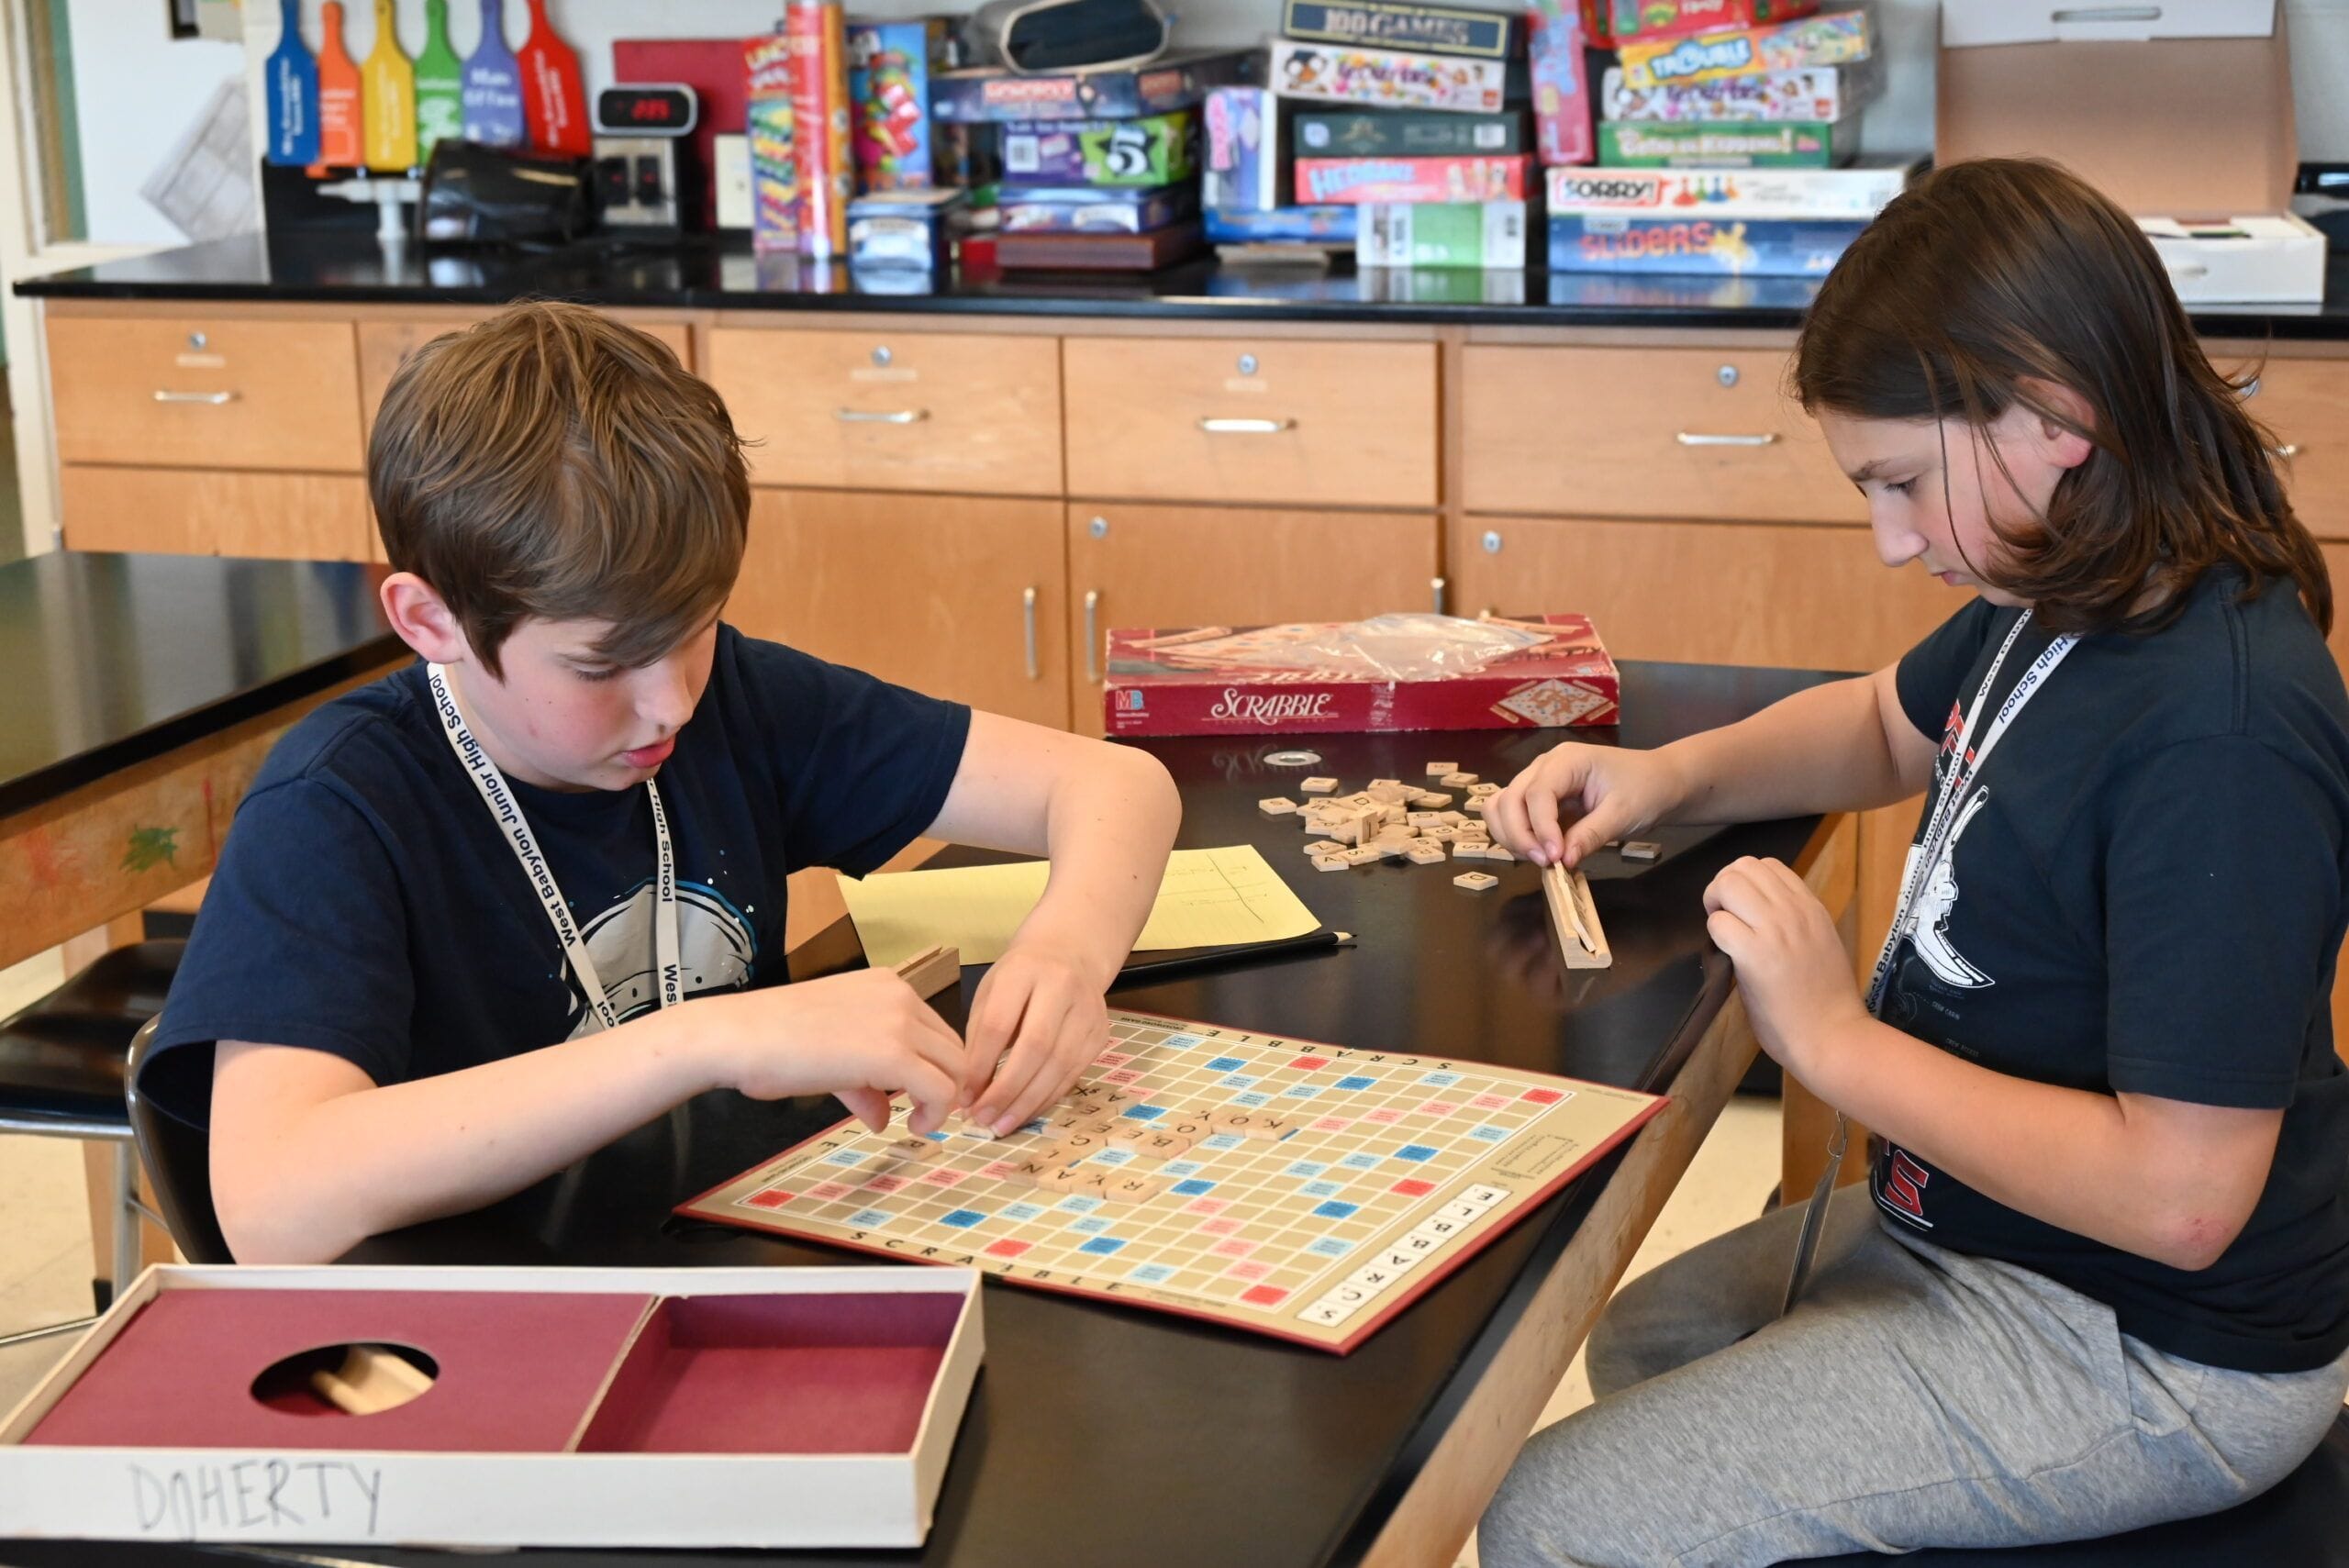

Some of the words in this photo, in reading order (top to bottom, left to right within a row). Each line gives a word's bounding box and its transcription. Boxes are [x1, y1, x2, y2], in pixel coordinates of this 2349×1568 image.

[1107, 128, 1147, 177] 5
[1978, 660, 2001, 697] West
[2039, 635, 2069, 671] High
[429, 673, 462, 730] School
[1115, 689, 1144, 711] MB
[1210, 688, 1332, 726] SCRABBLE
[1998, 671, 2038, 725] School
[457, 732, 486, 771] High
[481, 770, 518, 825] Junior
[512, 828, 555, 898] Babylon
[662, 840, 674, 903] School
[1876, 909, 1905, 973] Babylon
[1938, 751, 1962, 807] School
[551, 901, 577, 949] West
[129, 1458, 381, 1542] DOHERTY
